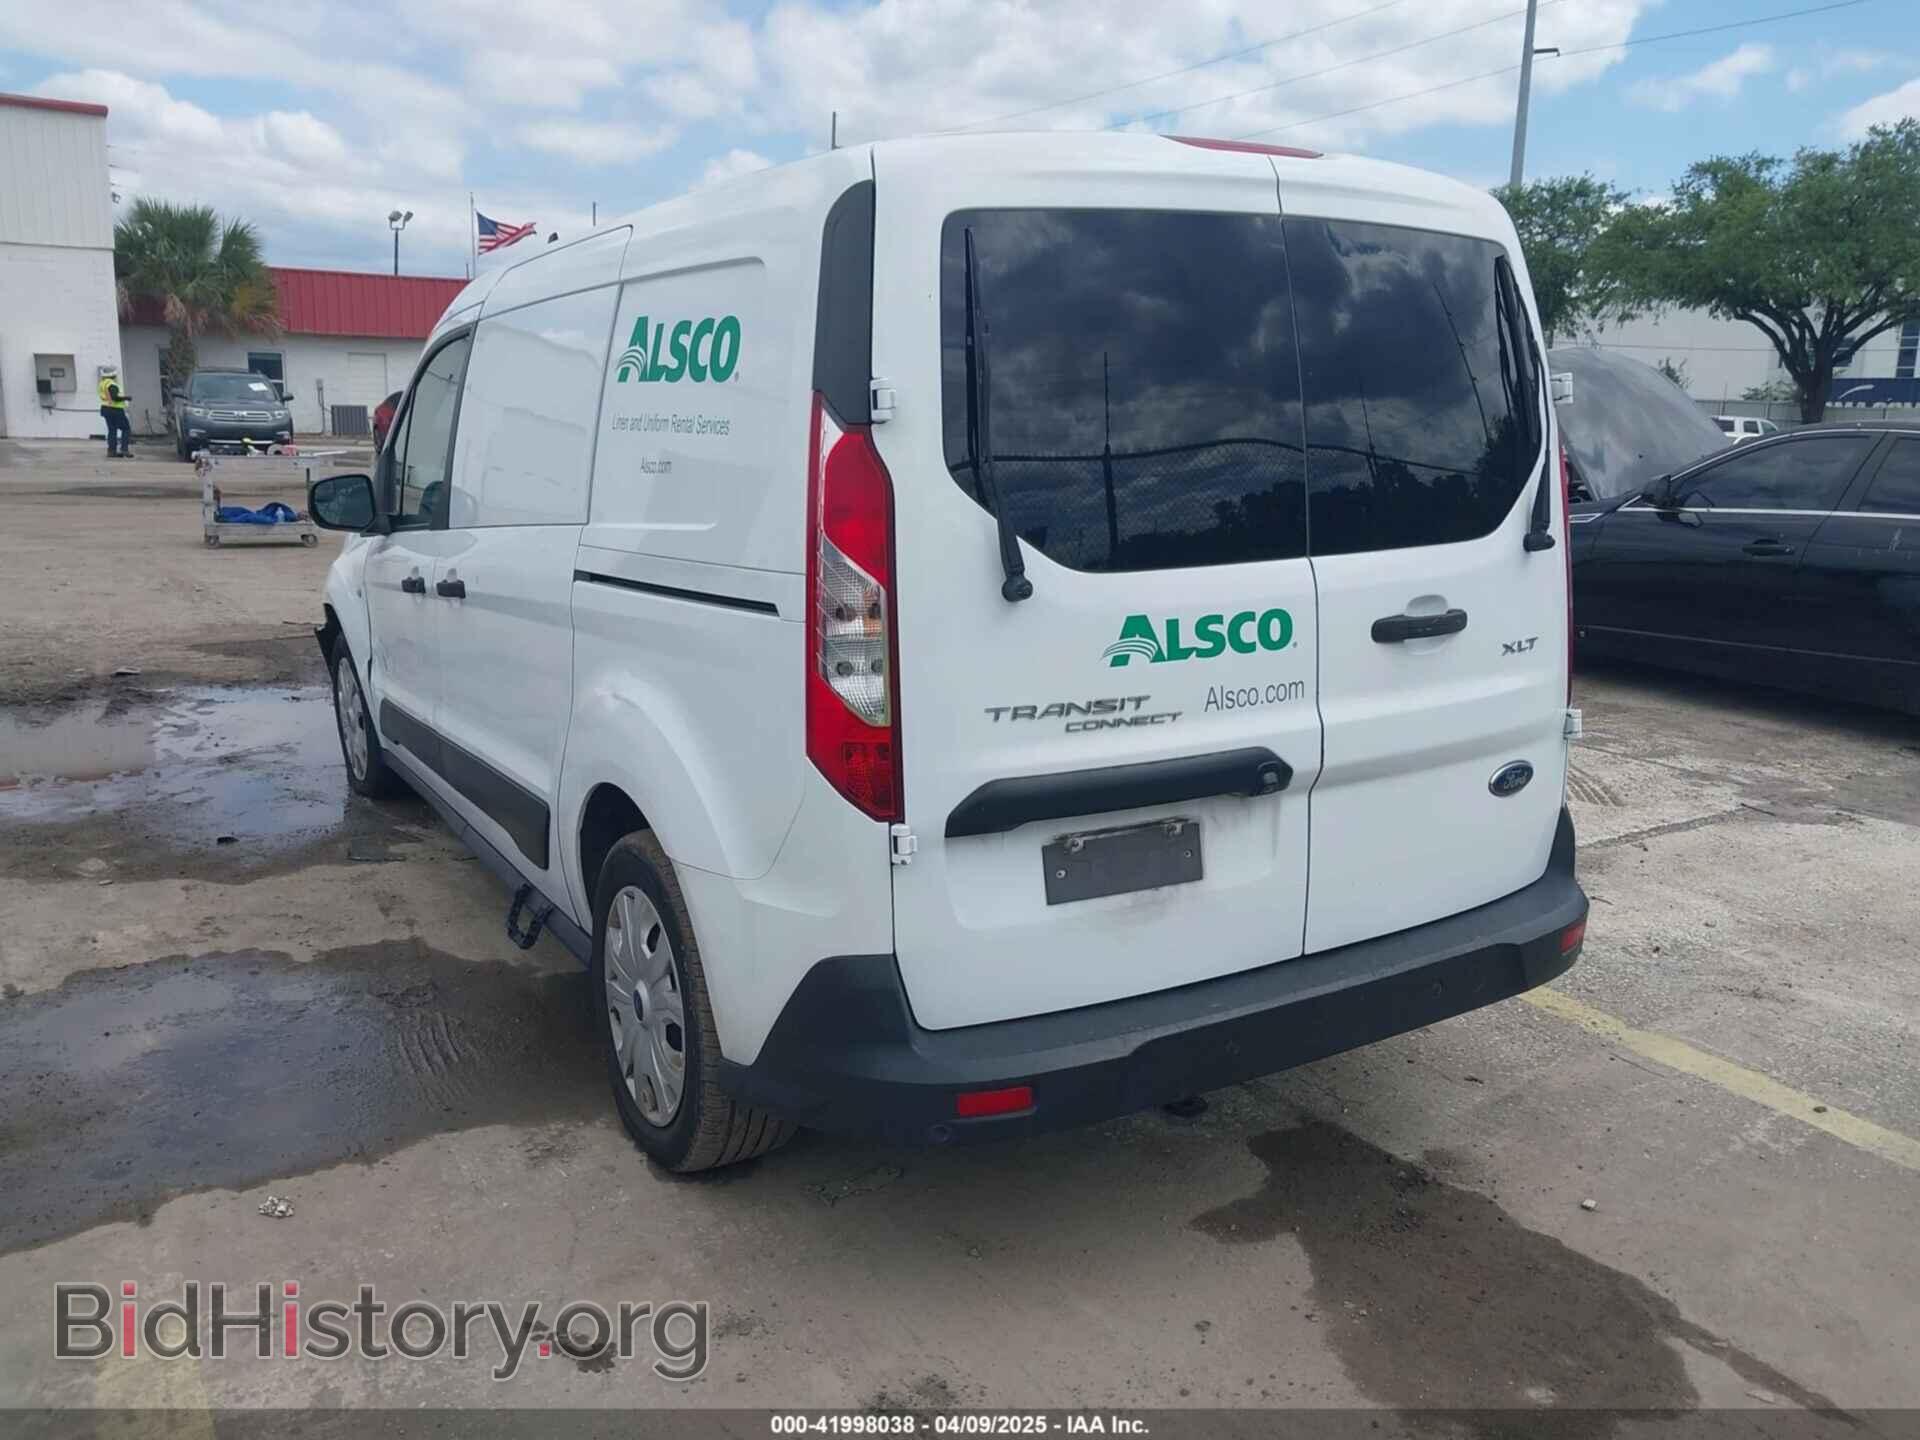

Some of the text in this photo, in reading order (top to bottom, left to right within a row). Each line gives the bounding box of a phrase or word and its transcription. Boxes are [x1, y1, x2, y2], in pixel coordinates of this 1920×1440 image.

[616, 315, 741, 383] ALSCO
[671, 414, 695, 434] Rental
[696, 414, 730, 436] Services
[1100, 608, 1294, 668] ALSCO
[1502, 636, 1539, 656] XLT
[984, 695, 1151, 723] TRANSIT
[1204, 679, 1305, 713] Alsco.com
[1065, 712, 1182, 733] CONNECT
